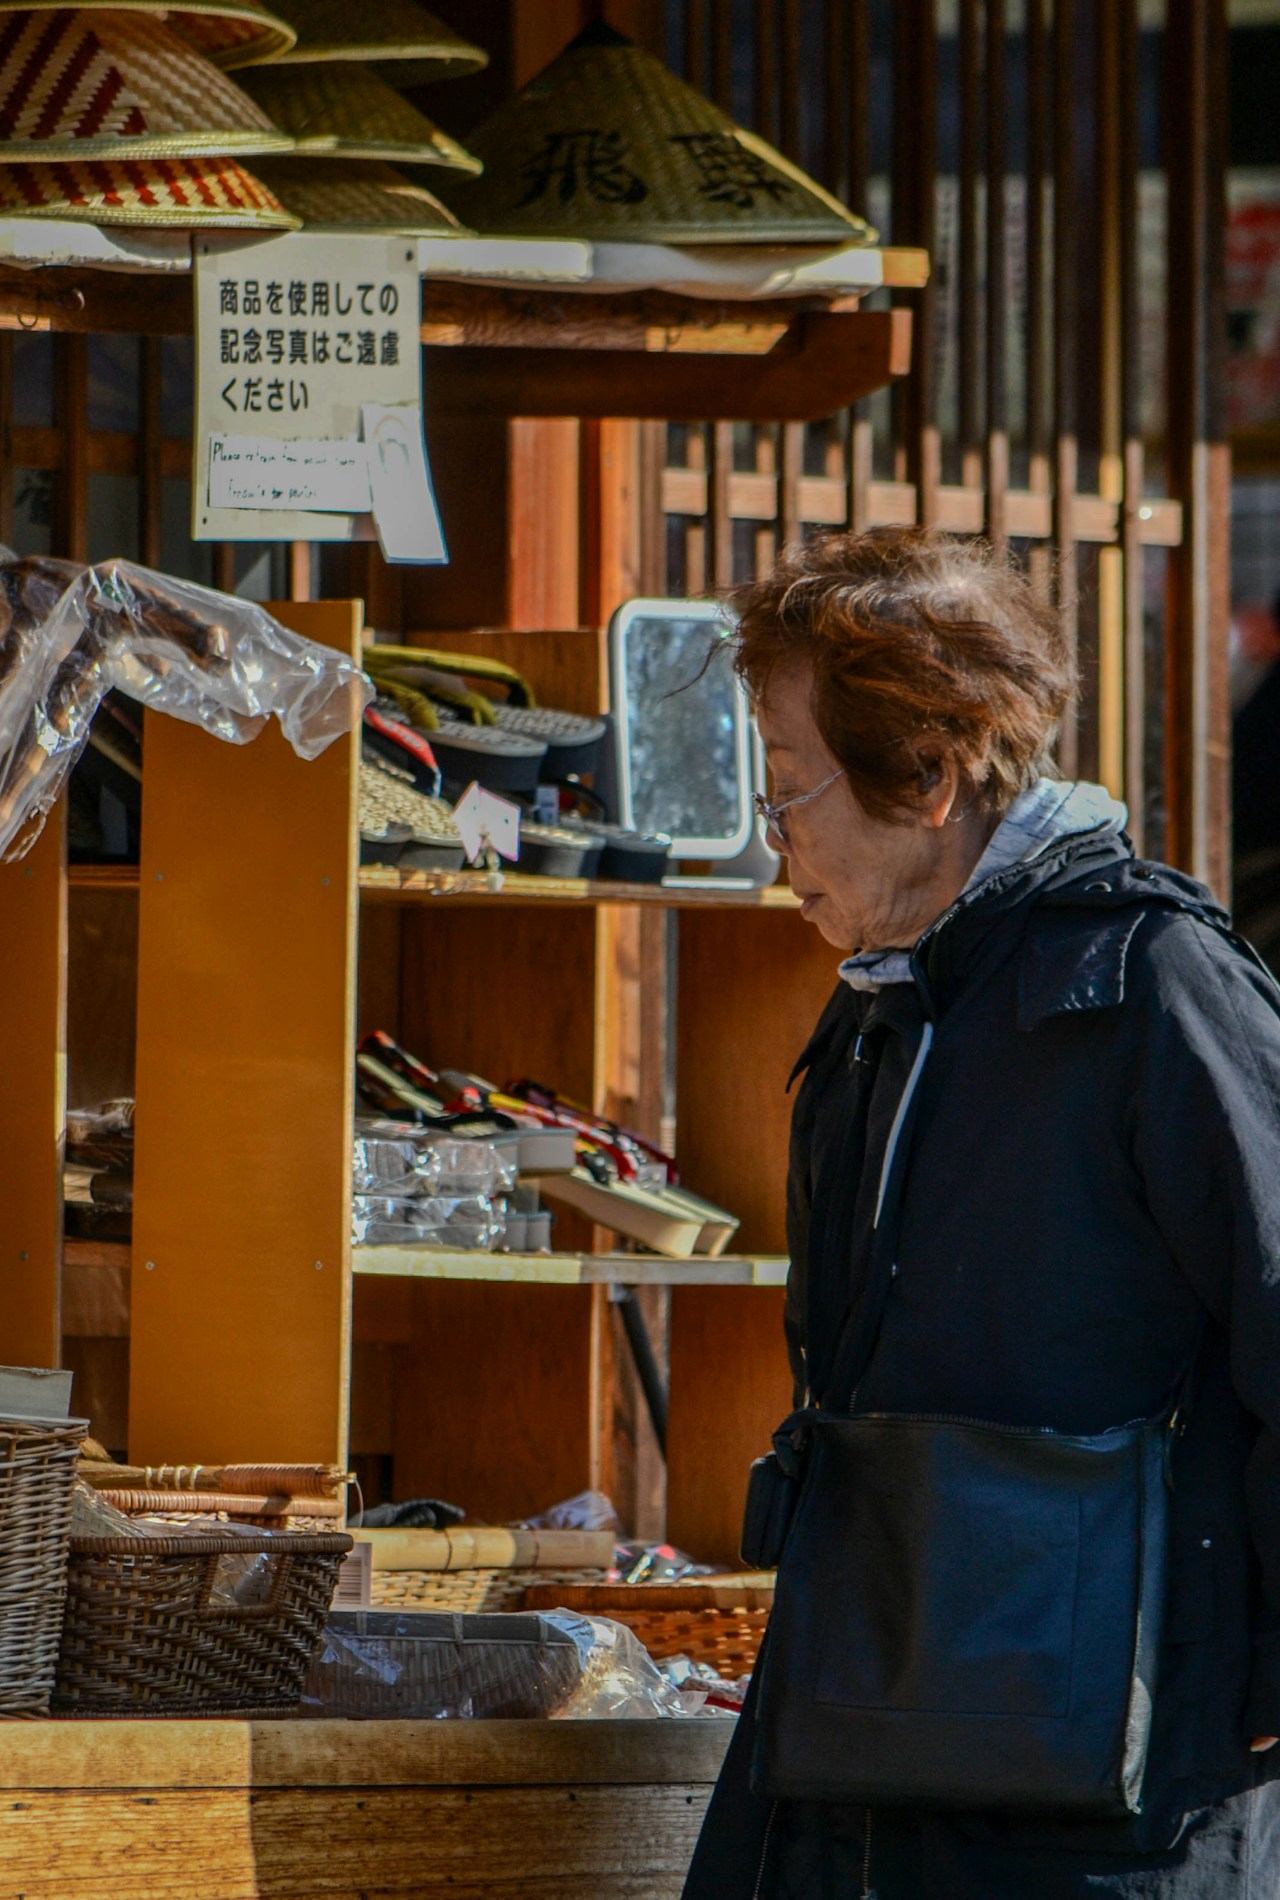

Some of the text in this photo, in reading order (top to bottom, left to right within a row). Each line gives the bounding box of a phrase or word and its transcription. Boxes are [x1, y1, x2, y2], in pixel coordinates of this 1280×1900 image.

[220, 279, 399, 316] 商品を使用しての
[220, 328, 400, 366] 記念写真はご遠慮
[221, 377, 310, 413] ください
